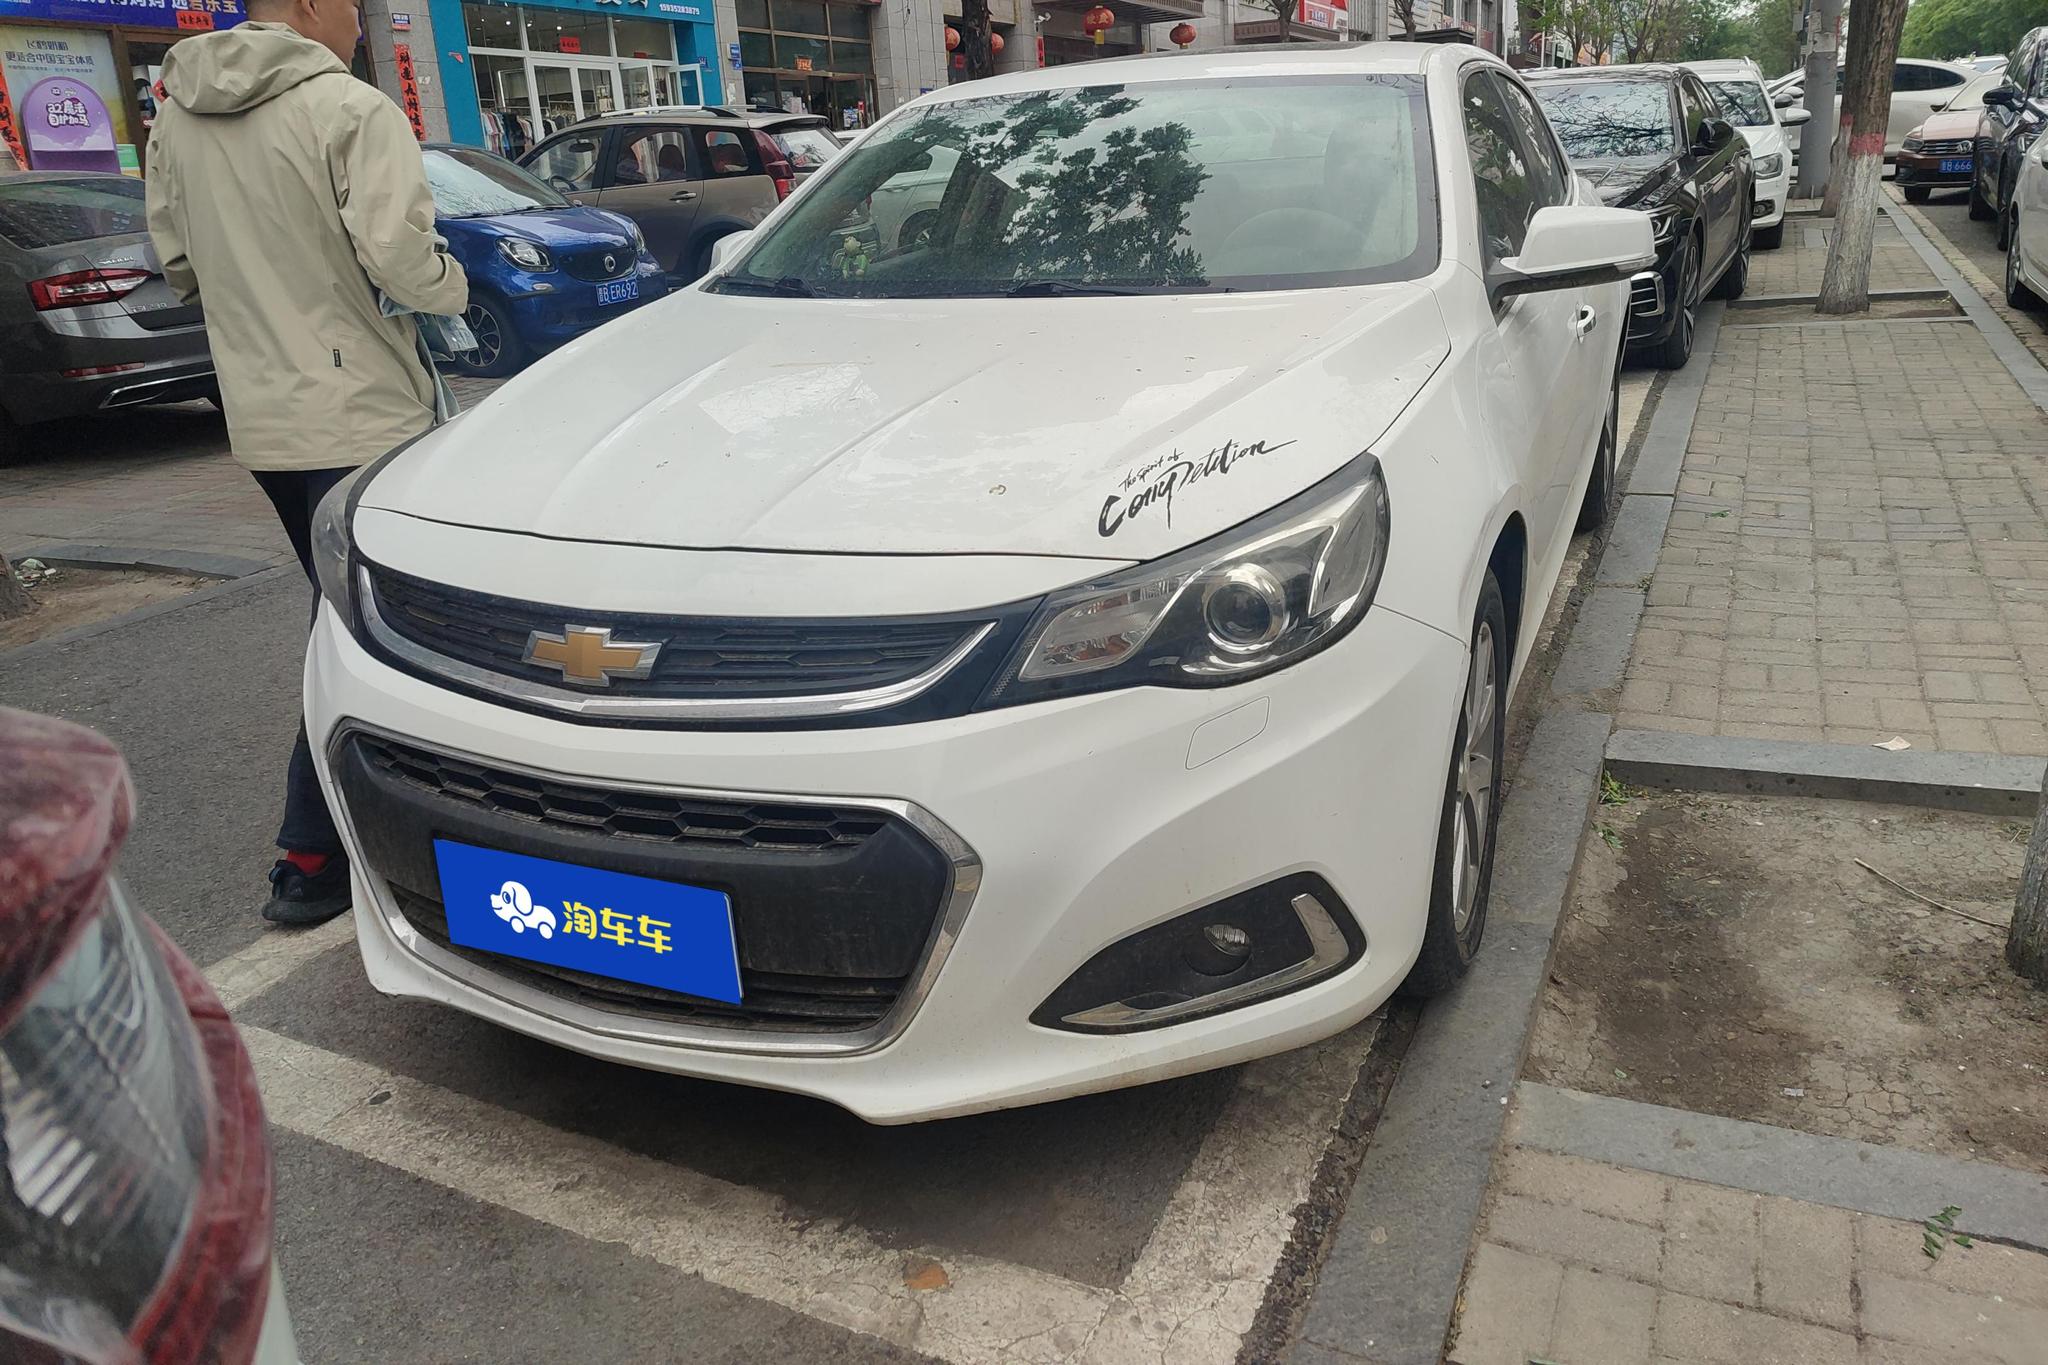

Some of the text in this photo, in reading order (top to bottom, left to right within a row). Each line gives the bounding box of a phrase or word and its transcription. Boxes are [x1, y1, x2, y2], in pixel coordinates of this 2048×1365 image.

[5, 50, 95, 66] 更适合中国宝宝体质
